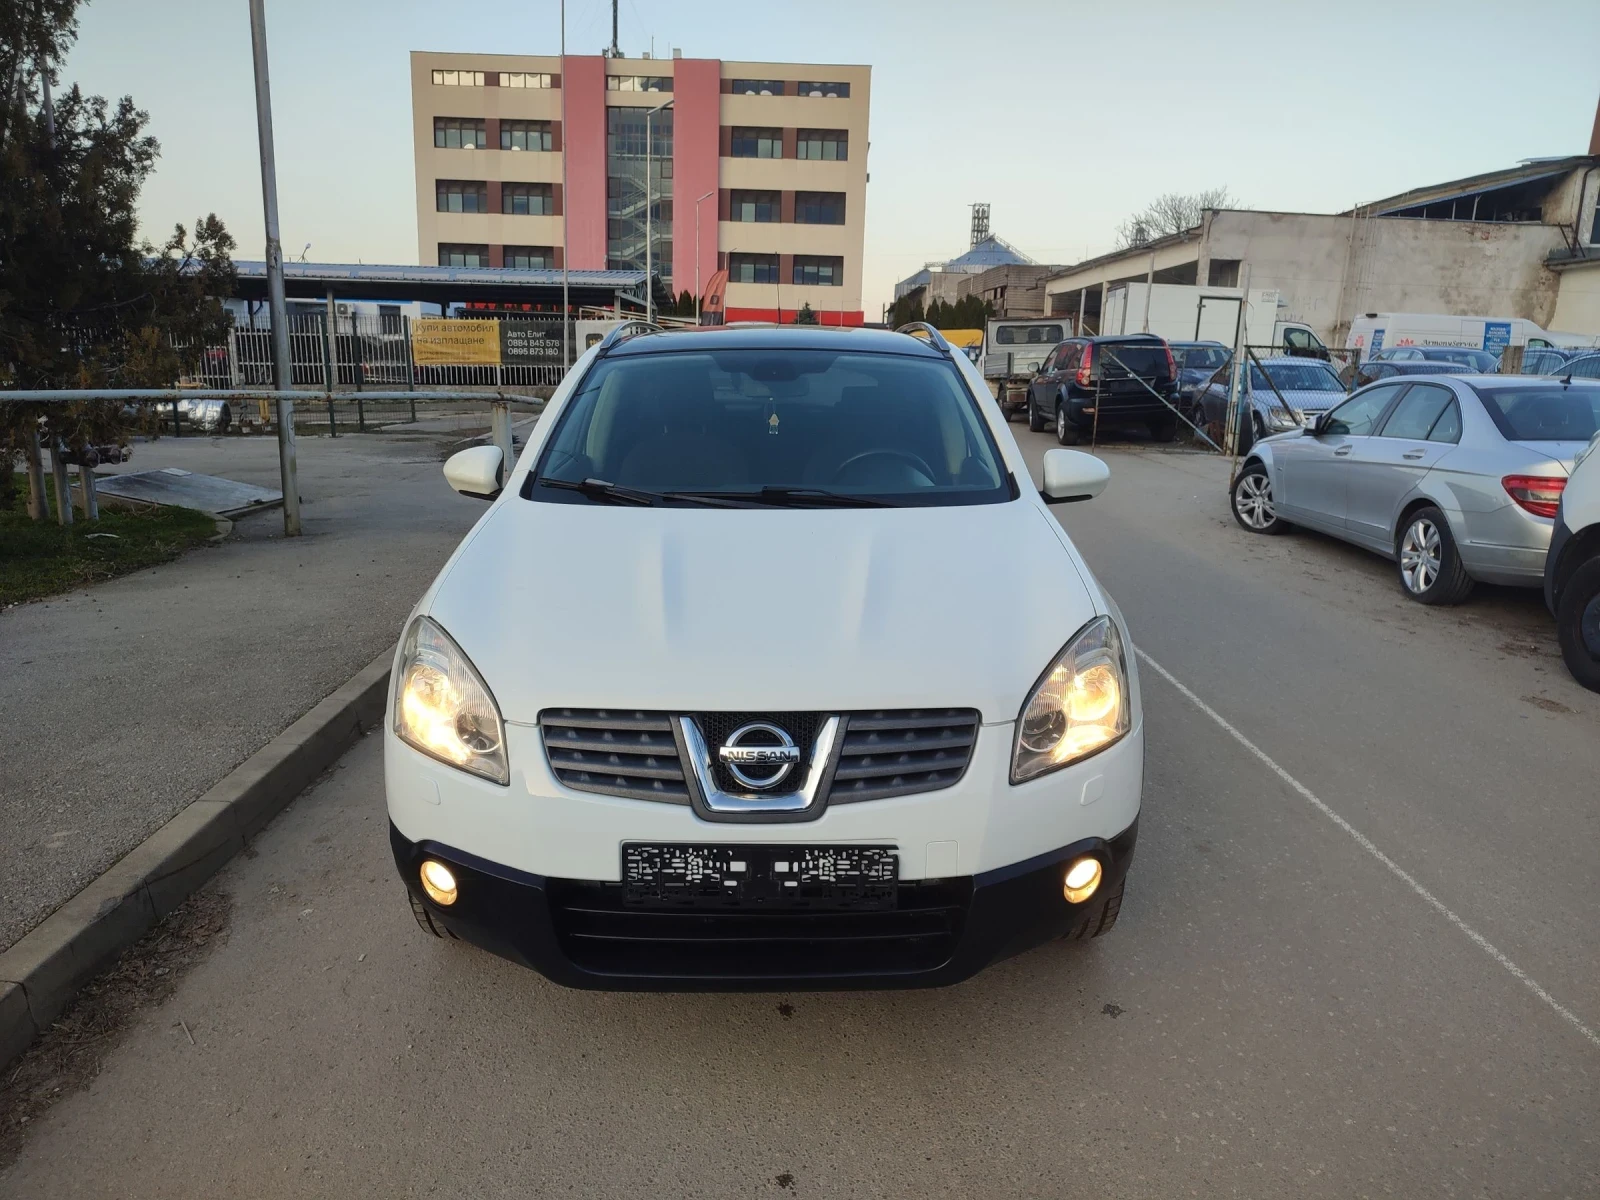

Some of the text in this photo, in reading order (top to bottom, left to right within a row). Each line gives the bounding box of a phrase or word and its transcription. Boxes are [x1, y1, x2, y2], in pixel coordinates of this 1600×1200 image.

[416, 323, 494, 333] Купи автомобил
[507, 330, 546, 338] Авто Елит
[416, 336, 485, 345] на изплащане
[507, 339, 560, 347] 0884 845 578
[507, 347, 559, 355] 0895 873 180
[728, 750, 792, 761] NISSAN
